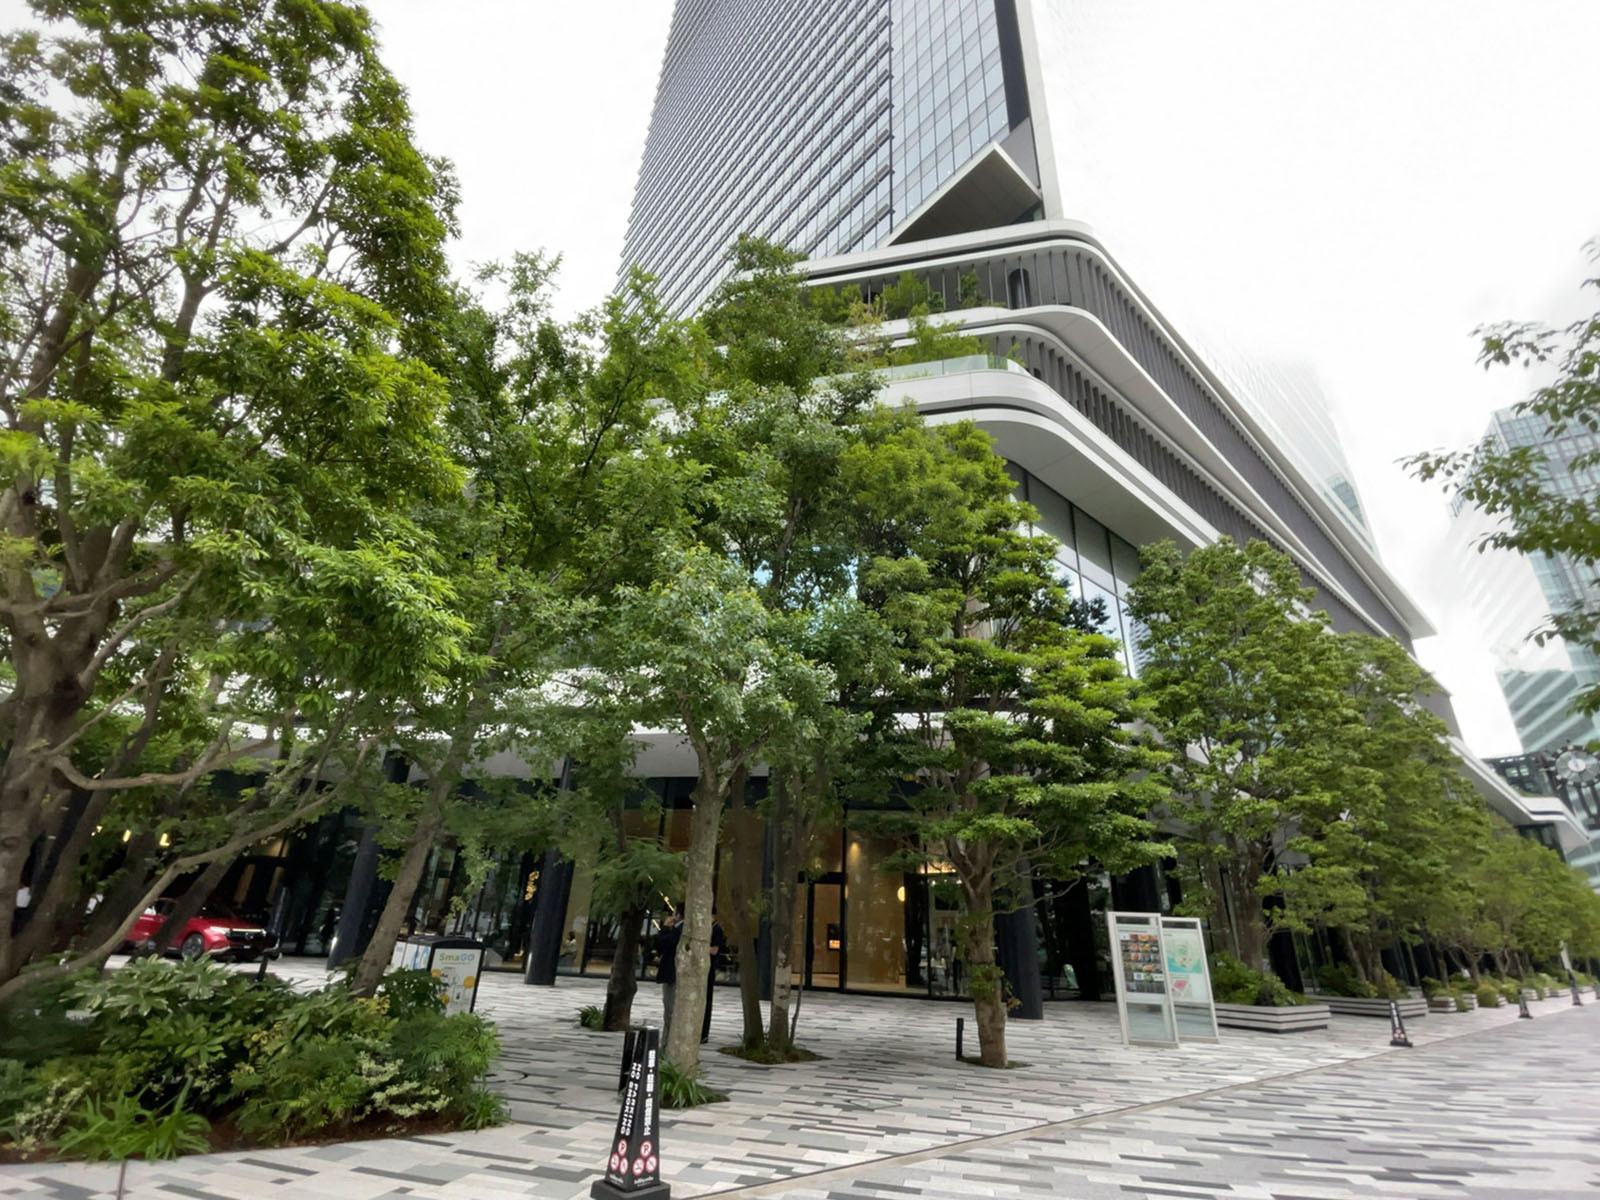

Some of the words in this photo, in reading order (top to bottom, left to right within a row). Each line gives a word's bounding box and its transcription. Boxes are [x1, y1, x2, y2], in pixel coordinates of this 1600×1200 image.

[630, 1062, 637, 1078] NO
[635, 1063, 642, 1079] NO
[620, 1081, 633, 1134] SMOKING
[625, 1083, 638, 1136] PARKING
